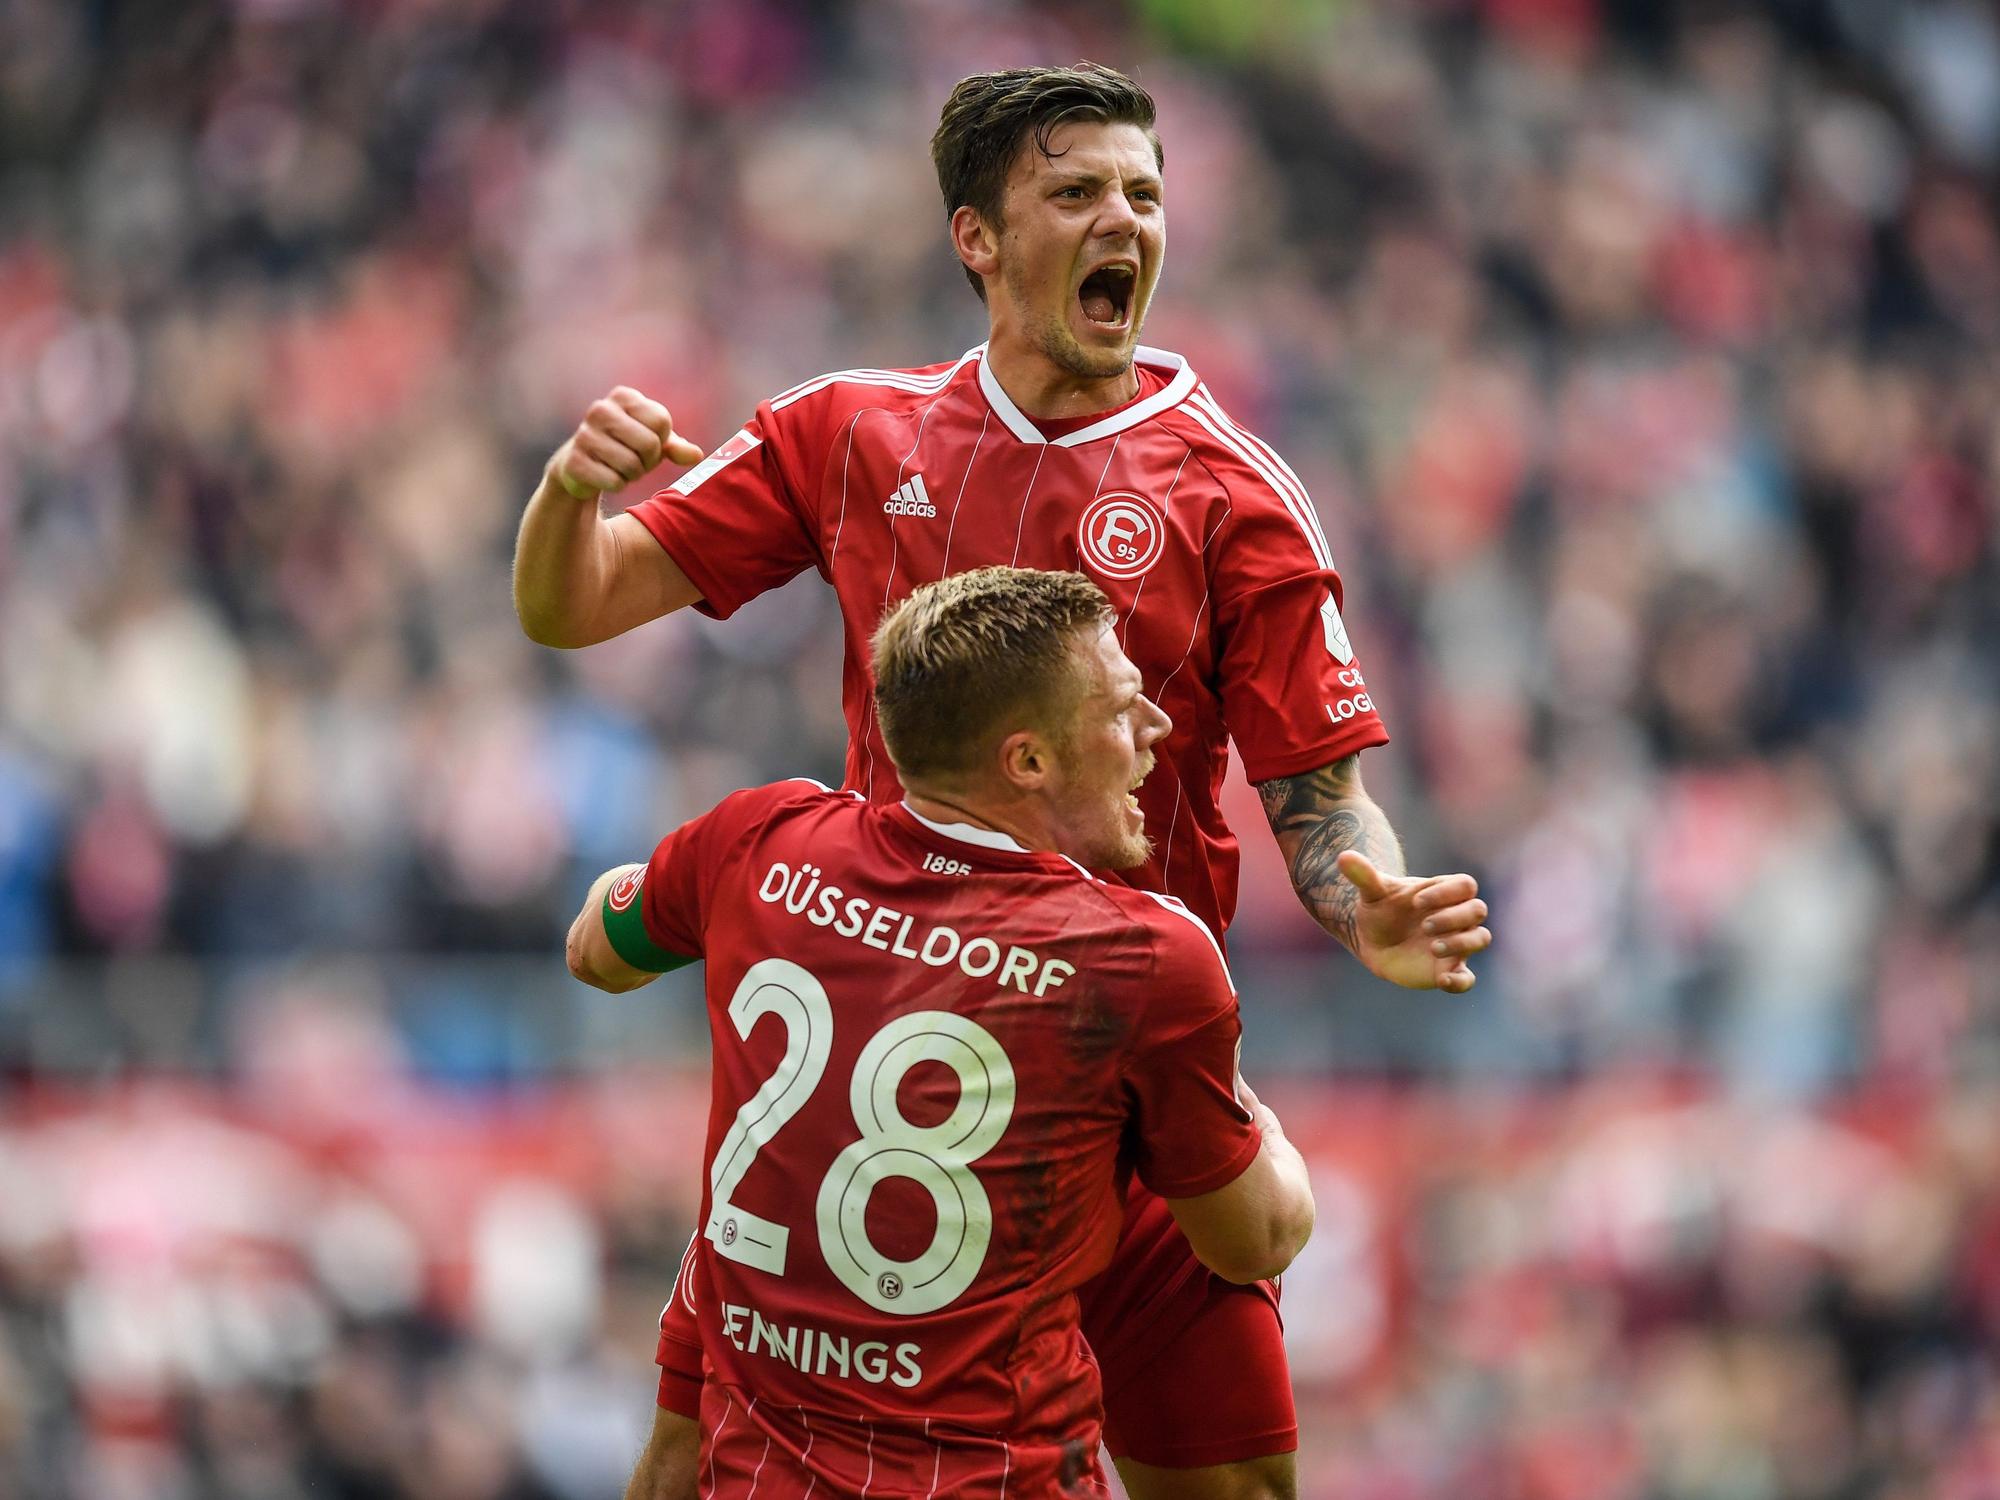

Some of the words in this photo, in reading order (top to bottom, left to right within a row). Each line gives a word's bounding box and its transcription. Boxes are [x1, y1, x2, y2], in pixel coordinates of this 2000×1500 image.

[883, 500, 937, 518] adidas
[1116, 543, 1138, 561] 95
[922, 852, 972, 876] 1895
[758, 862, 1077, 999] DÜSSELDORF
[703, 957, 1017, 1315] 28
[721, 1300, 922, 1388] ENNINGS
